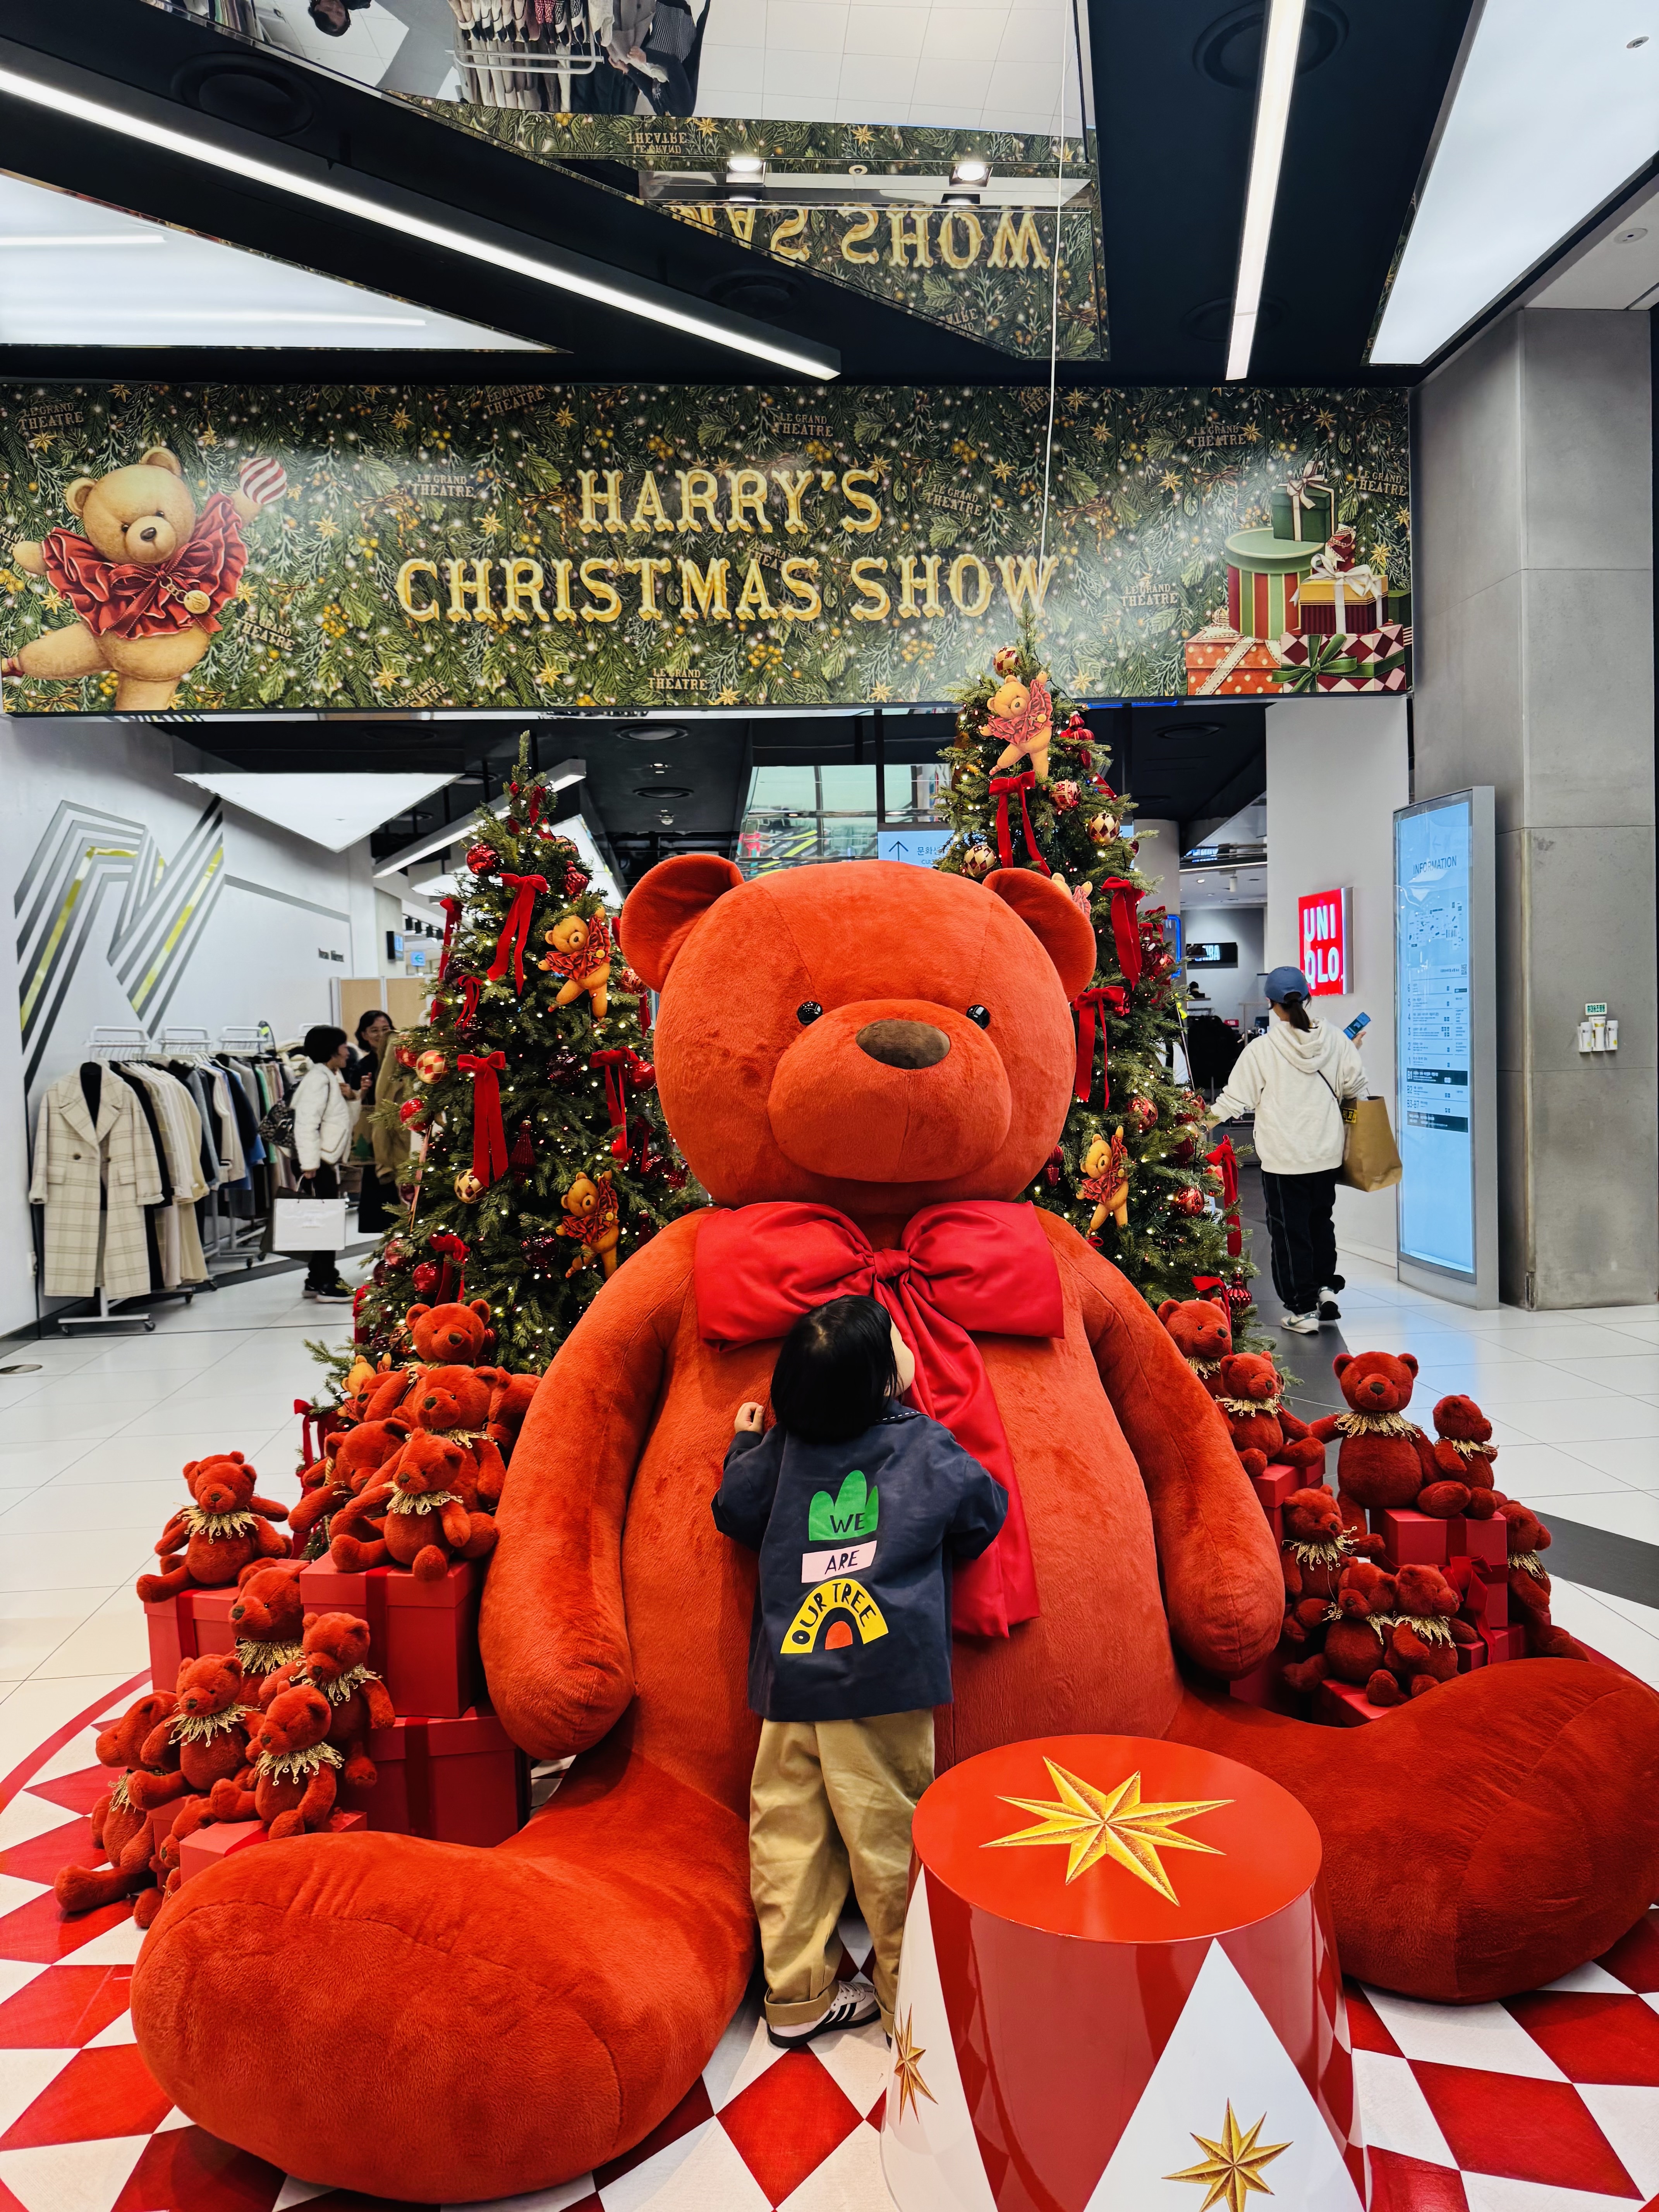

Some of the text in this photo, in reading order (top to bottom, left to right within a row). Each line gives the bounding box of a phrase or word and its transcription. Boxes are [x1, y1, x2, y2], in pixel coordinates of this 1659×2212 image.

[40, 403, 74, 415] GRAND
[484, 389, 545, 416] THEATRE
[19, 412, 84, 430] THEATRE
[780, 412, 827, 424] LE GRAND
[1193, 426, 1239, 435] LE GRAND
[1189, 434, 1246, 447] THEATRE
[417, 474, 467, 484] LE GRAND
[1352, 478, 1407, 496] THEATRE
[1372, 472, 1402, 484] GRAND
[411, 483, 474, 498] THEATRE
[948, 488, 978, 503] GRAND
[577, 469, 881, 534] HARRY'S
[926, 492, 983, 516] THEATRE
[395, 553, 1060, 622] CHRISTMAS SHOW
[1120, 592, 1180, 606] THEATRE
[235, 618, 295, 651] THEATRE
[653, 668, 666, 677] LE
[406, 677, 436, 700] GRAND
[647, 678, 708, 690] THEATRE
[1413, 855, 1457, 875] INFORMATION
[1304, 903, 1336, 942] UNI
[1305, 946, 1340, 990] QLO
[1408, 1027, 1411, 1036] 3
[1408, 1042, 1411, 1050] 2
[830, 1511, 866, 1534] WE
[825, 1550, 860, 1575] ARE
[791, 1582, 877, 1645] OUR TREE
